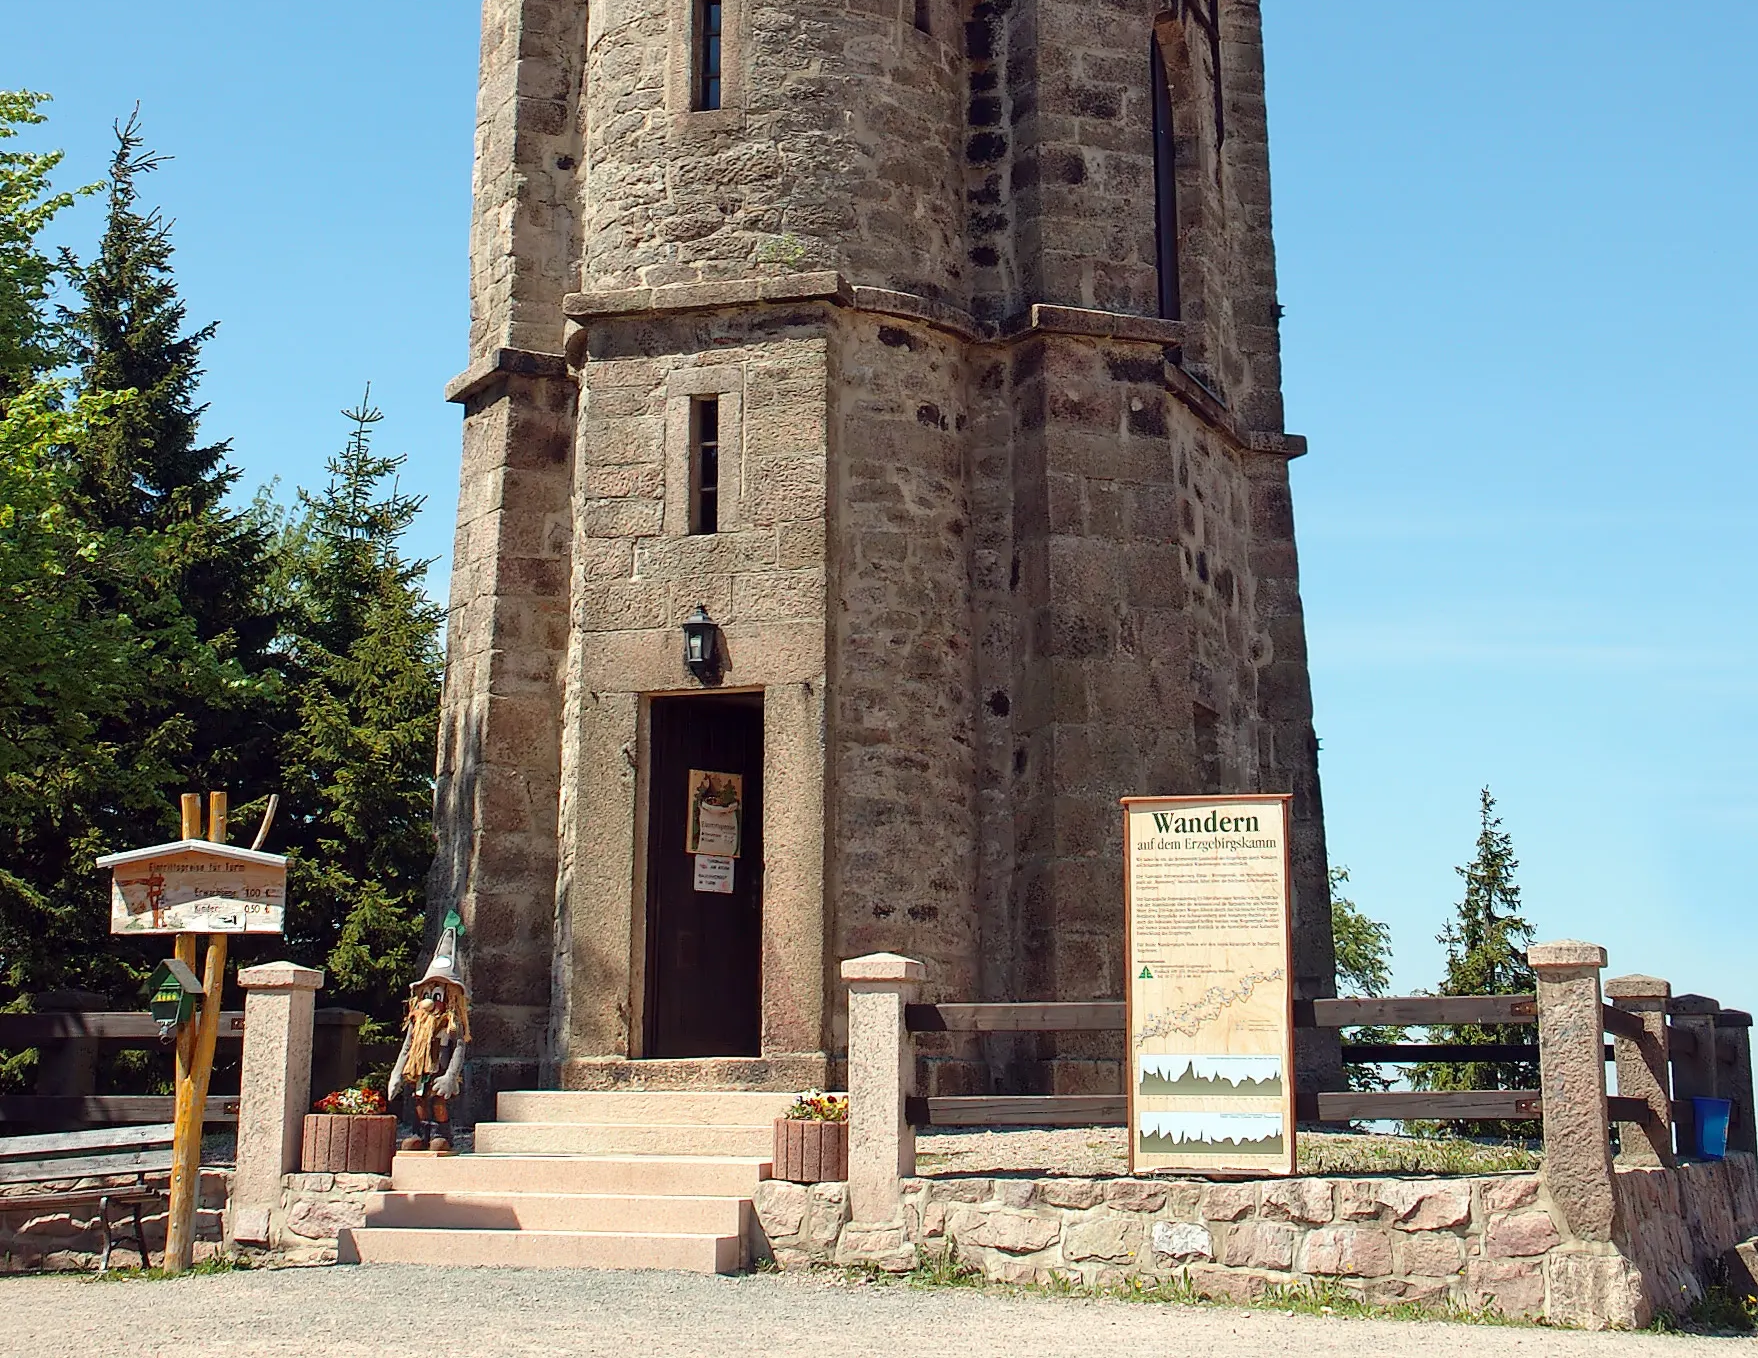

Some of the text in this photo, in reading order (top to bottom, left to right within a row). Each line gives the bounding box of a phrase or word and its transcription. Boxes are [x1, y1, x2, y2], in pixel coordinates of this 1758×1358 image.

[1152, 810, 1260, 833] Wandern
[1137, 836, 1277, 852] auf dem Erzgebirgskamm
[149, 861, 245, 873] Eintrittspreise für Turm
